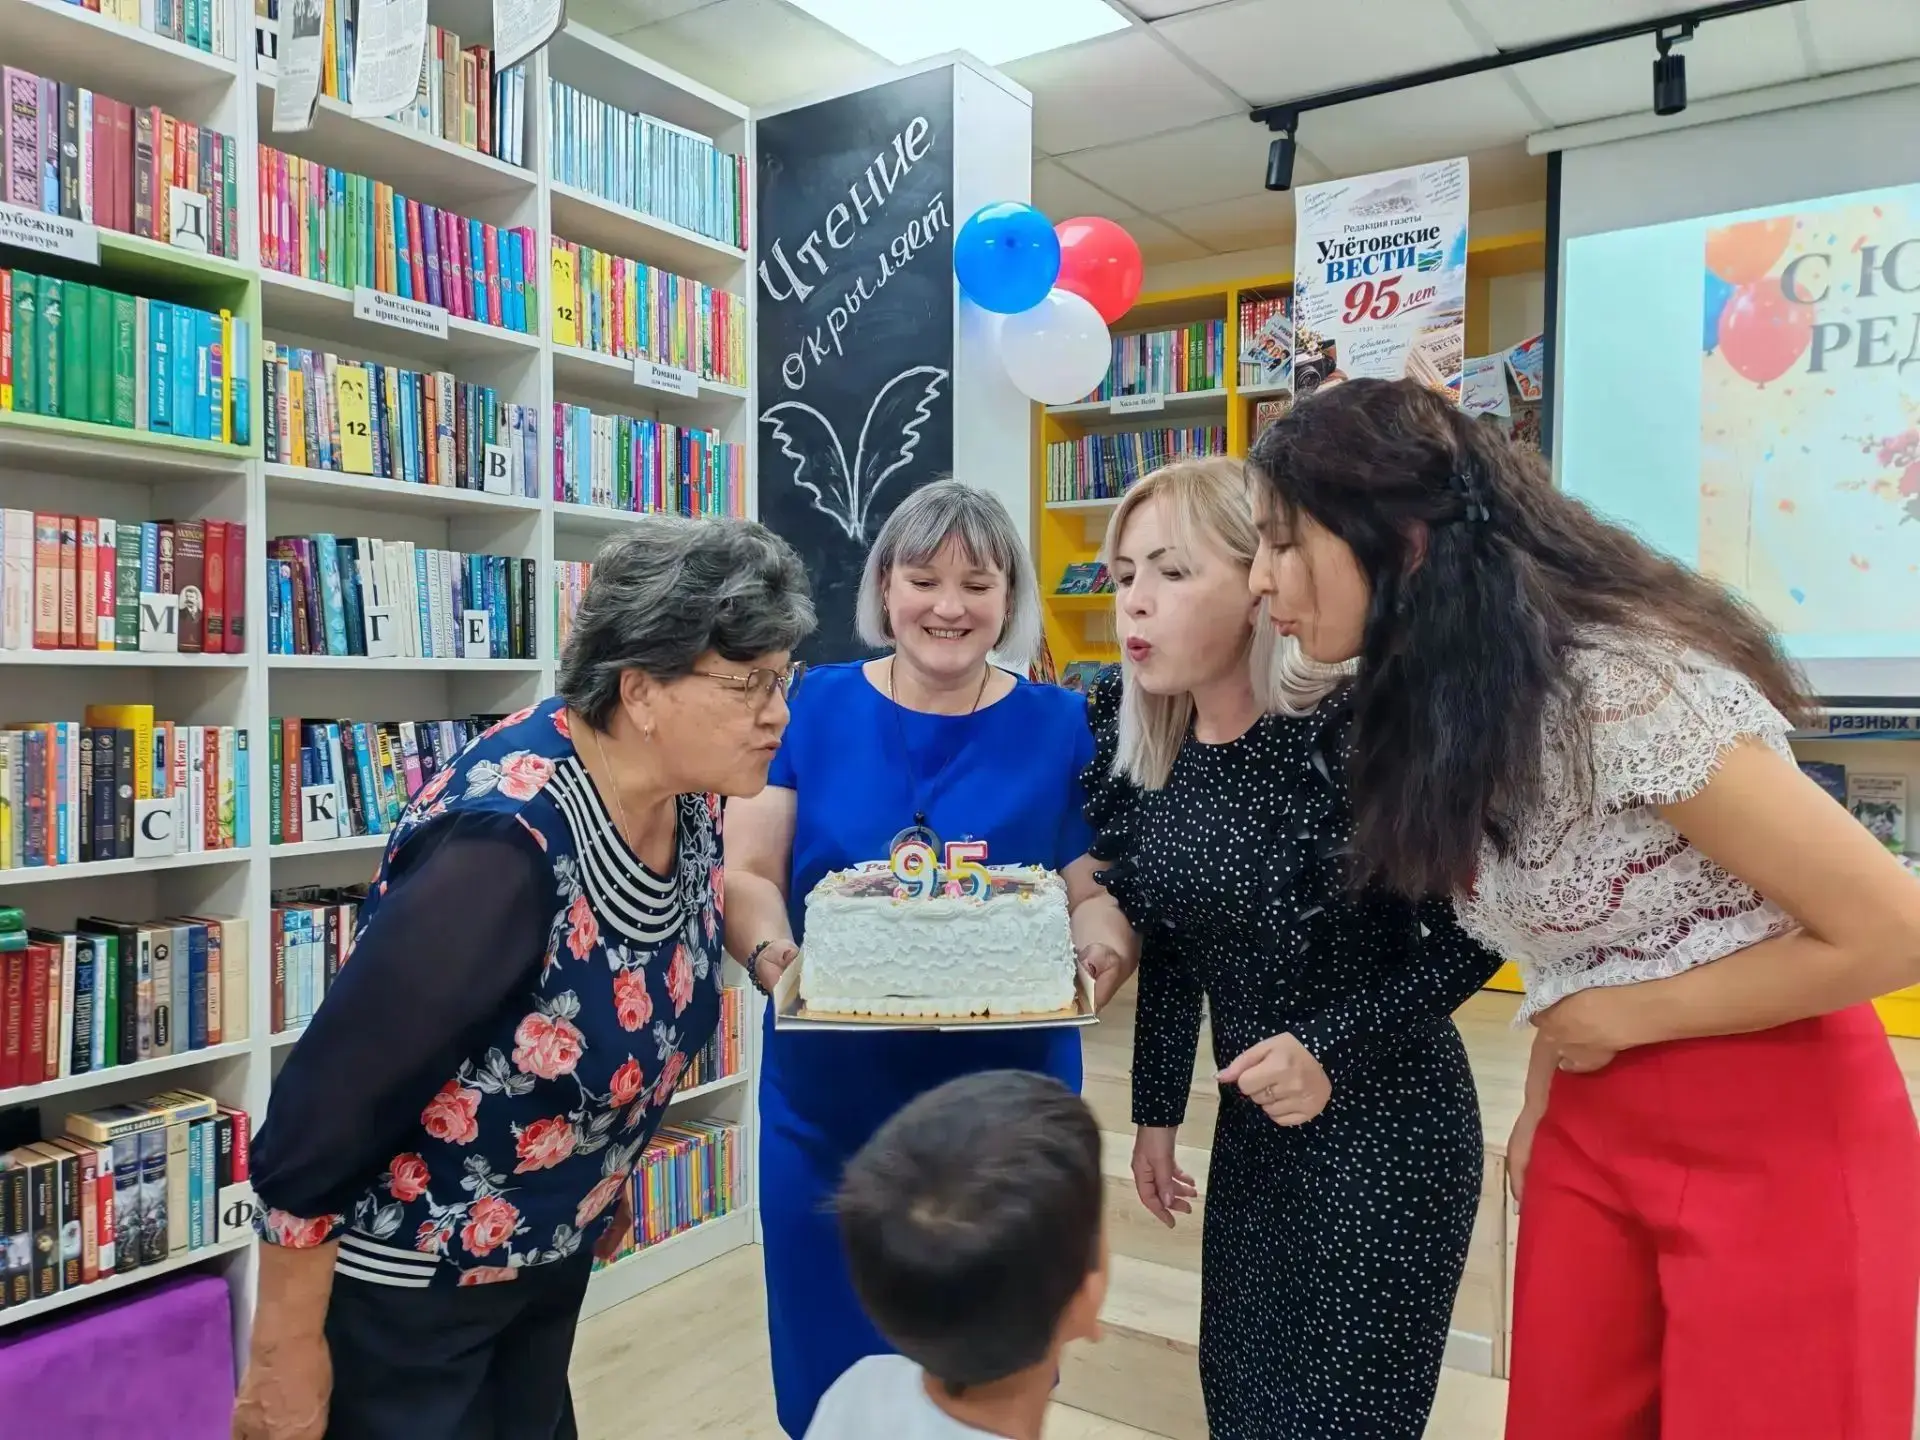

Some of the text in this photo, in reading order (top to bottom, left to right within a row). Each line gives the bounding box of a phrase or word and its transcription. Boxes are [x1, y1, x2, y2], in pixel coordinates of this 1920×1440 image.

[176, 201, 205, 246] Д
[757, 116, 931, 304] Чтение
[1343, 214, 1422, 234] Редакция газеты
[1316, 225, 1441, 265] Улётовские
[1326, 246, 1416, 284] ВЕСТИ
[1780, 252, 1832, 305] С
[374, 294, 432, 317] Фантастика
[1342, 275, 1437, 325] 95 лет
[363, 306, 440, 333] и приключения
[651, 366, 682, 382] Романы
[490, 451, 507, 478] В
[139, 603, 177, 635] М
[367, 613, 389, 642] Г
[467, 618, 486, 645] Е
[1829, 715, 1910, 734] разных
[174, 739, 187, 768] Кихот
[305, 792, 334, 823] К
[140, 809, 172, 841] С
[889, 840, 993, 902] 95
[223, 1200, 252, 1229] Ф
